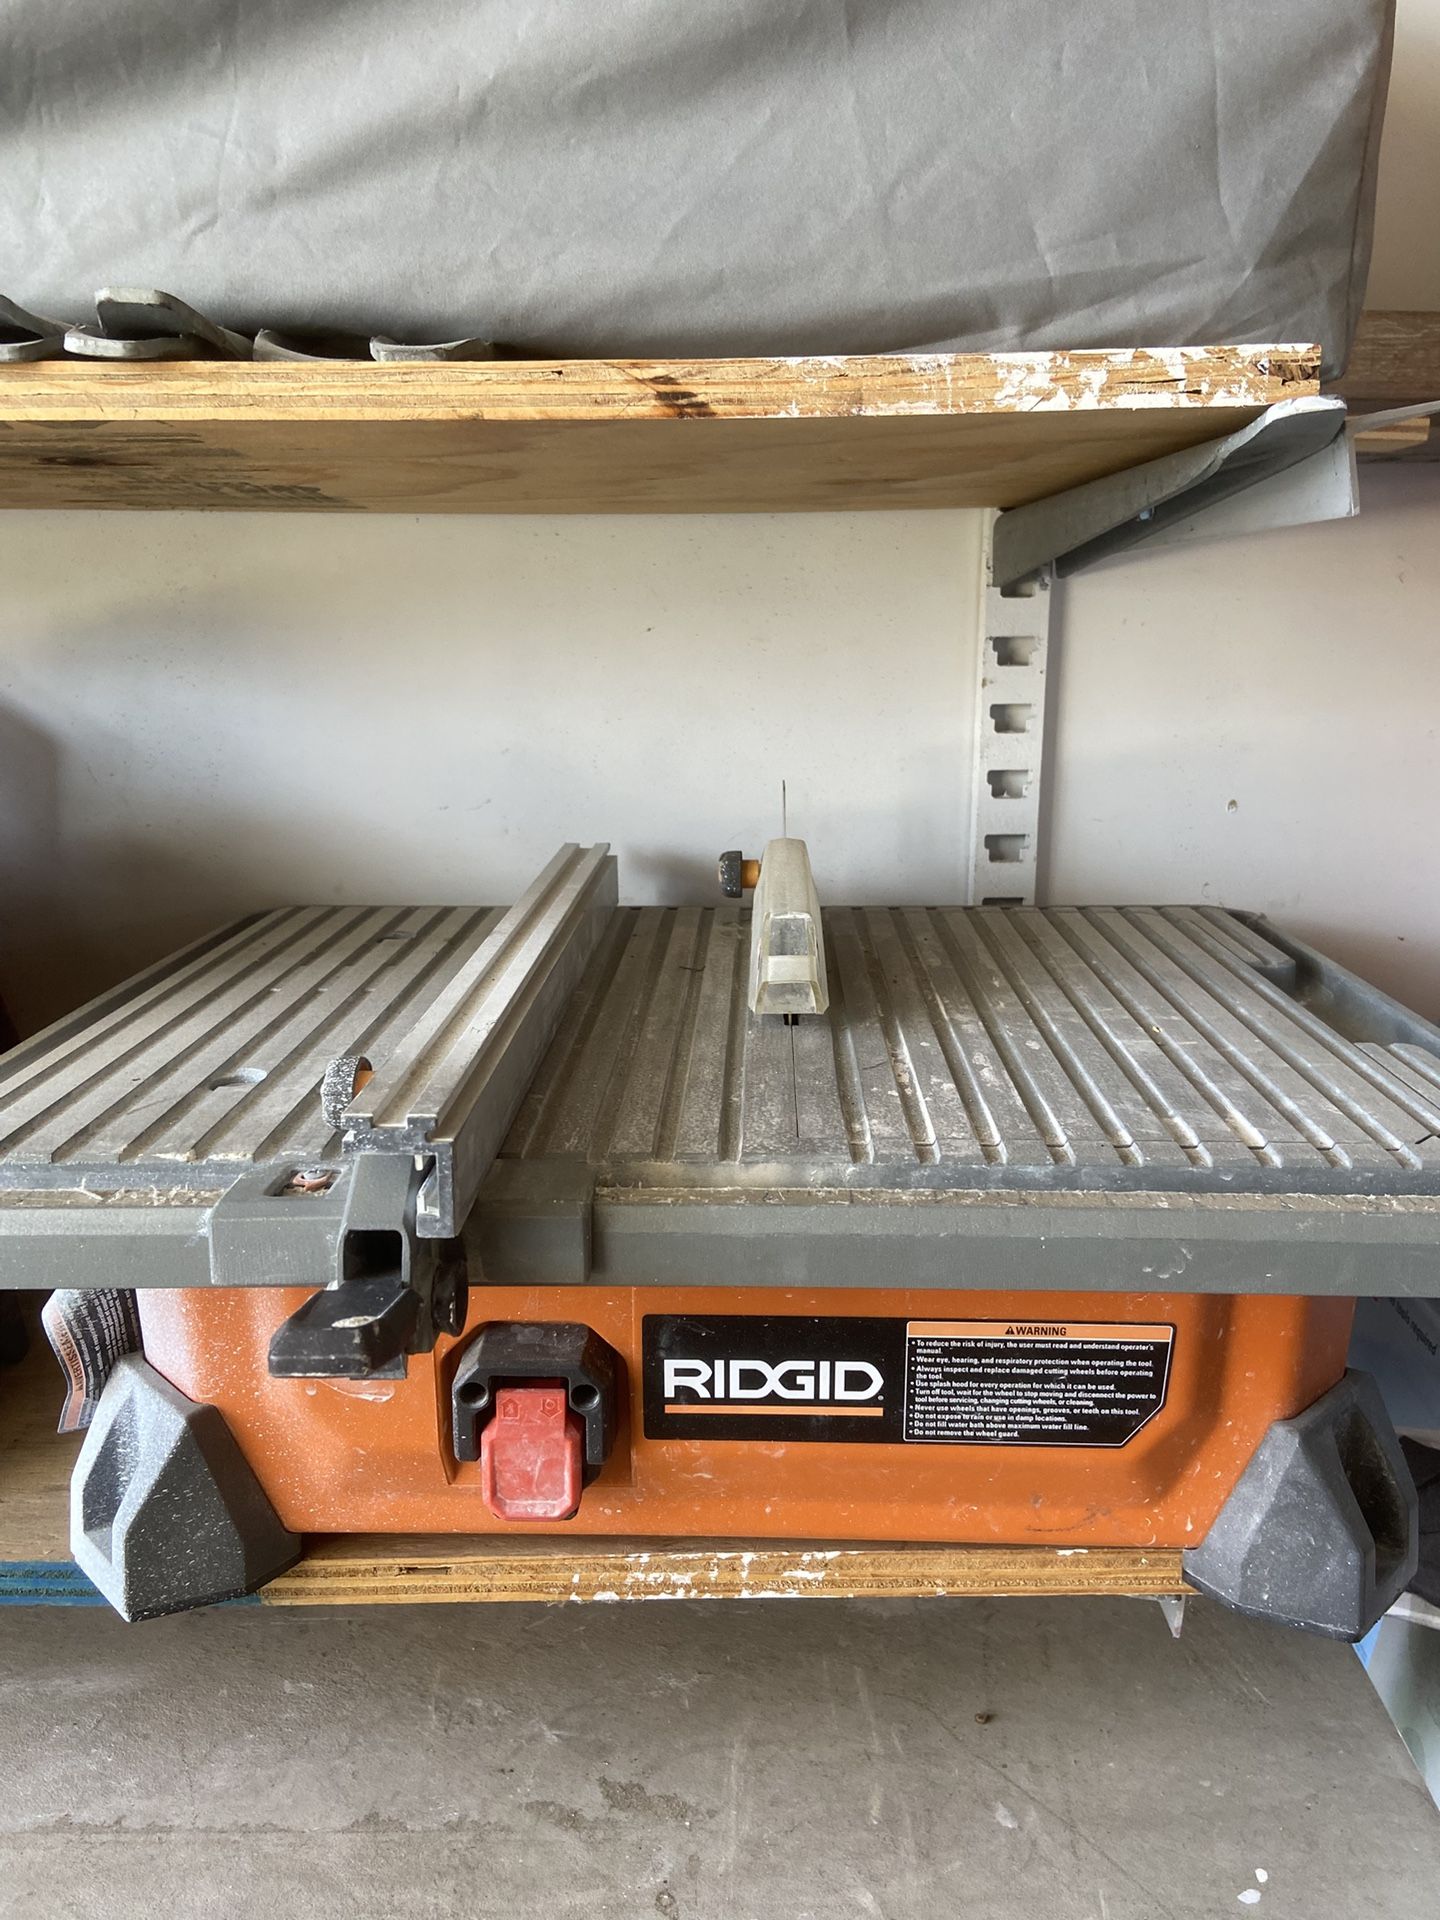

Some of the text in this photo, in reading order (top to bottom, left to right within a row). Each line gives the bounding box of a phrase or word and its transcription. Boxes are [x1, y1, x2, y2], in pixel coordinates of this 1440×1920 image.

[1016, 1326, 1067, 1336] WARNING
[985, 1341, 1006, 1349] injury,
[952, 1357, 980, 1365] hearing,
[995, 1357, 1033, 1366] respiratory
[1034, 1358, 1069, 1366] protection
[1091, 1359, 1124, 1367] operating
[916, 1365, 942, 1374] Always
[943, 1366, 969, 1374] inspect
[984, 1367, 1010, 1375] replace
[1011, 1367, 1043, 1375] damaged
[1044, 1368, 1068, 1376] cutting
[1120, 1369, 1153, 1377] operating
[663, 1359, 884, 1400] RIDGID
[930, 1380, 951, 1389] splash
[999, 1381, 1032, 1390] operation
[941, 1389, 955, 1397] tool,
[1024, 1390, 1038, 1398] stop
[1039, 1390, 1063, 1399] moving
[949, 1396, 979, 1405] servicing,
[980, 1397, 1009, 1405] changing
[1010, 1397, 1032, 1406] cutting
[1032, 1398, 1057, 1406] wheels,
[1066, 1398, 1095, 1407] cleaning.
[1008, 1406, 1041, 1414] openings,
[1015, 1414, 1034, 1422] damp
[998, 1430, 1020, 1438] guard.
